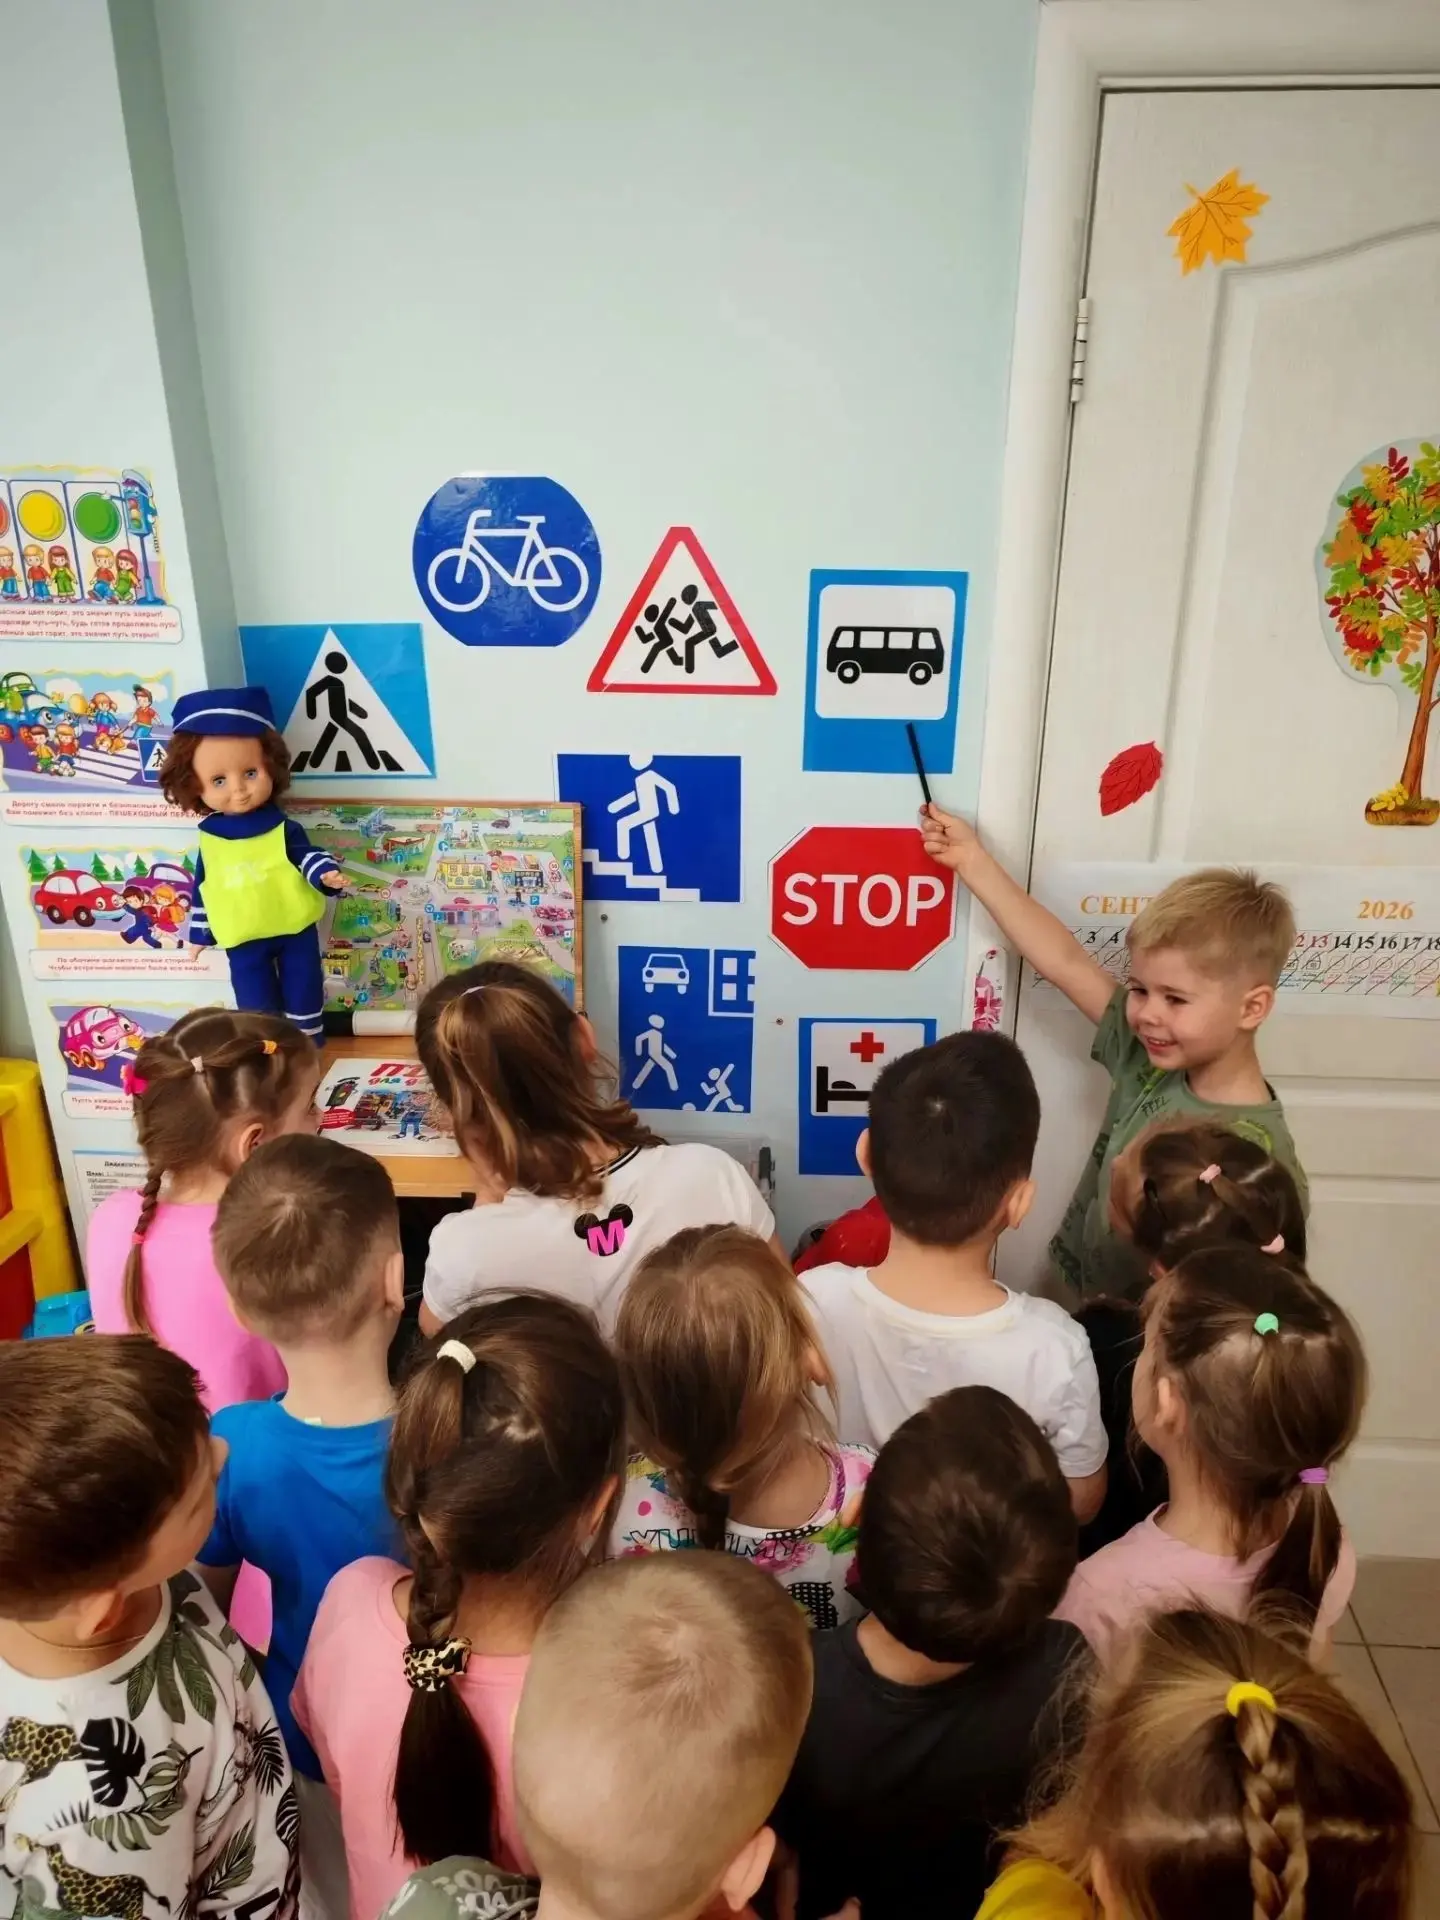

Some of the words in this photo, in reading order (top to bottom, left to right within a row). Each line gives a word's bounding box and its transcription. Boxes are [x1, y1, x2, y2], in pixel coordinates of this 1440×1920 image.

[781, 872, 946, 927] STOP
[1357, 899, 1416, 920] 2026
[1086, 931, 1096, 944] 3
[1311, 934, 1329, 948] 13
[1334, 934, 1352, 949] 14
[1358, 935, 1375, 950] 15
[1380, 935, 1398, 950] 16
[1403, 936, 1422, 951] 17
[587, 1218, 625, 1257] M
[630, 1528, 798, 1559] YUMY
